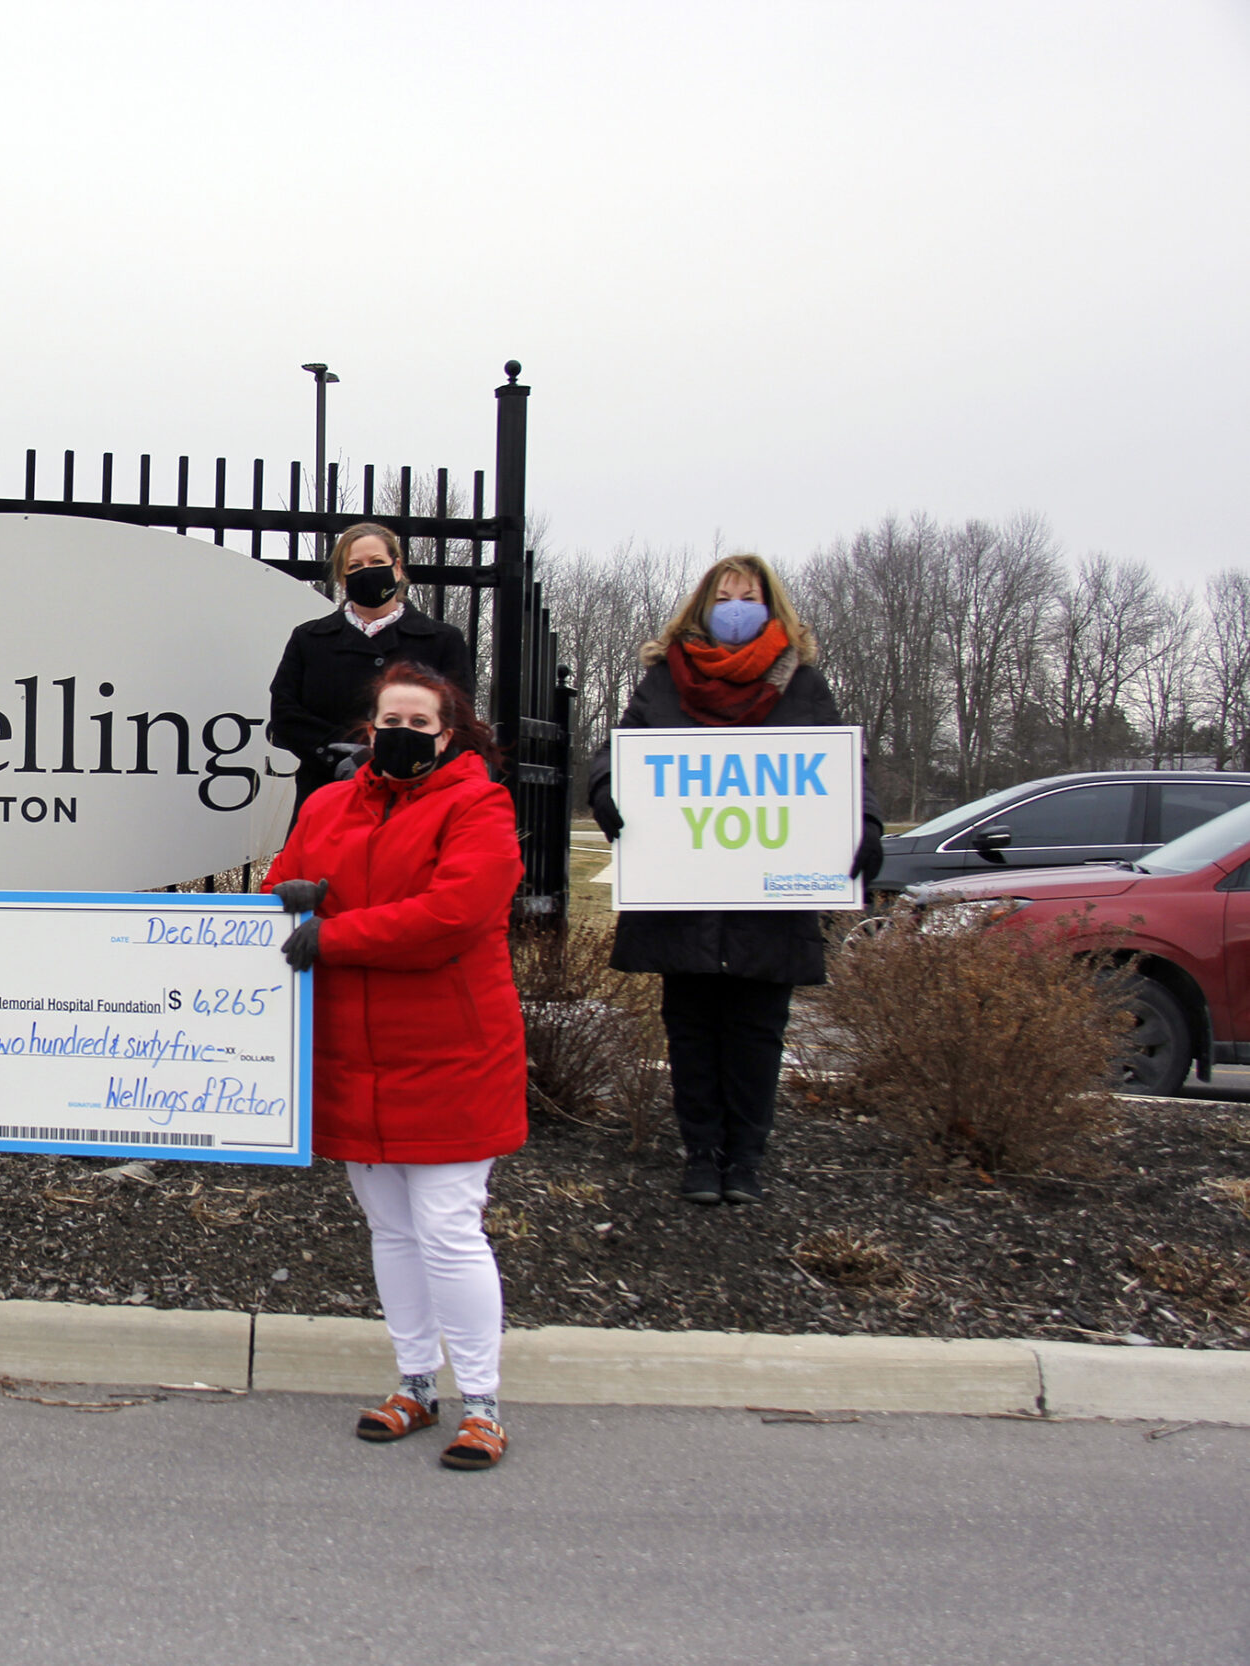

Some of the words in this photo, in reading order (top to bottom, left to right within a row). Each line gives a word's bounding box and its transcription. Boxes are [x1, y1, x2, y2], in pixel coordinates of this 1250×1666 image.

[644, 753, 828, 796] THANK
[681, 806, 789, 850] YOU
[769, 873, 792, 882] Love
[794, 873, 811, 882] the
[811, 872, 849, 884] County
[769, 882, 792, 891] Back
[793, 882, 810, 891] the
[811, 882, 836, 891] Build
[147, 917, 193, 944] Dec
[220, 919, 273, 947] 2020
[48, 998, 94, 1013] Hospital
[98, 999, 161, 1014] Foundation
[168, 988, 182, 1011] $
[30, 1021, 110, 1056] hundred
[123, 1030, 170, 1069] sixty
[106, 1077, 188, 1125] Wellings
[192, 1077, 216, 1112] of
[215, 1077, 286, 1116] Picton
